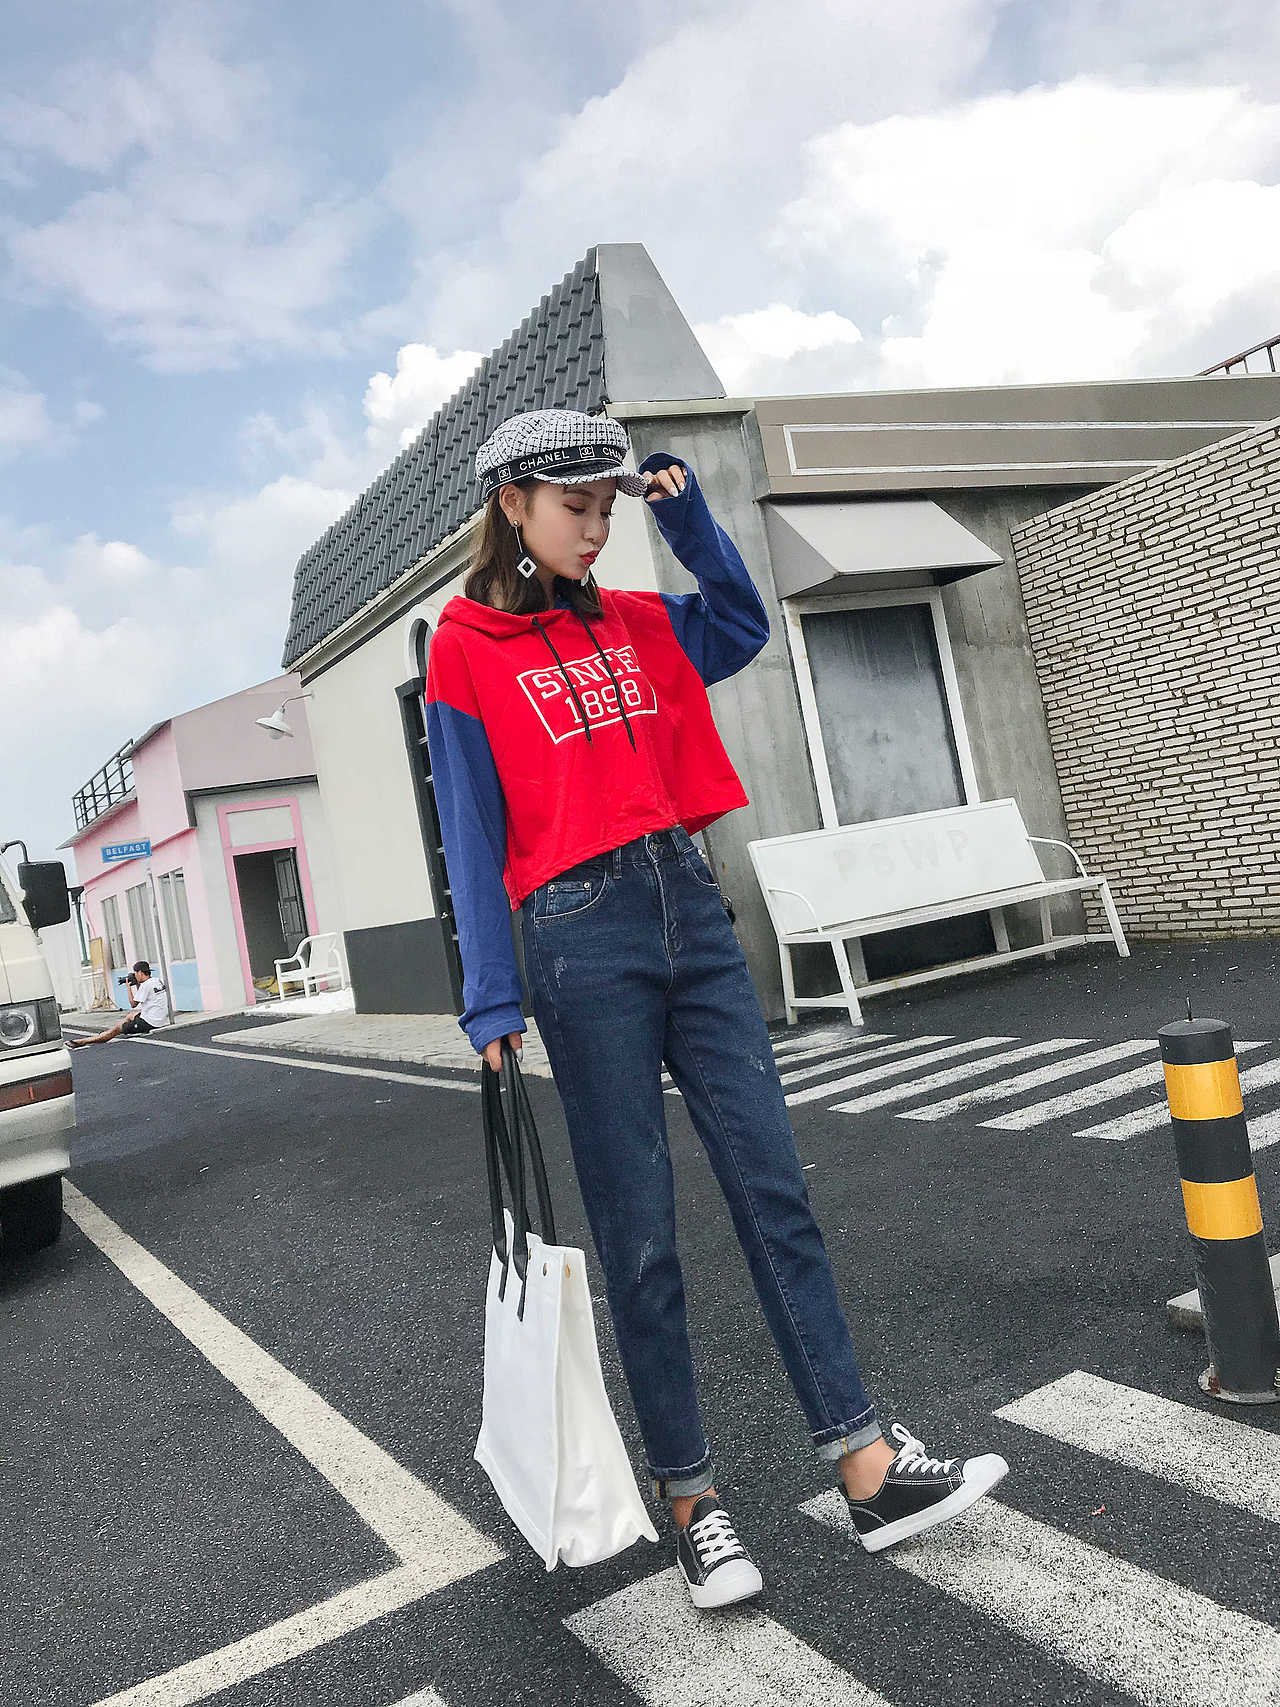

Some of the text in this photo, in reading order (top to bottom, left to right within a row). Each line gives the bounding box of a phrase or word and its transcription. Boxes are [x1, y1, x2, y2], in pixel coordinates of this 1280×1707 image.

[519, 450, 570, 471] CHANEL
[531, 652, 642, 700] SINCE
[564, 679, 642, 724] 1898
[105, 843, 147, 856] BELFAST
